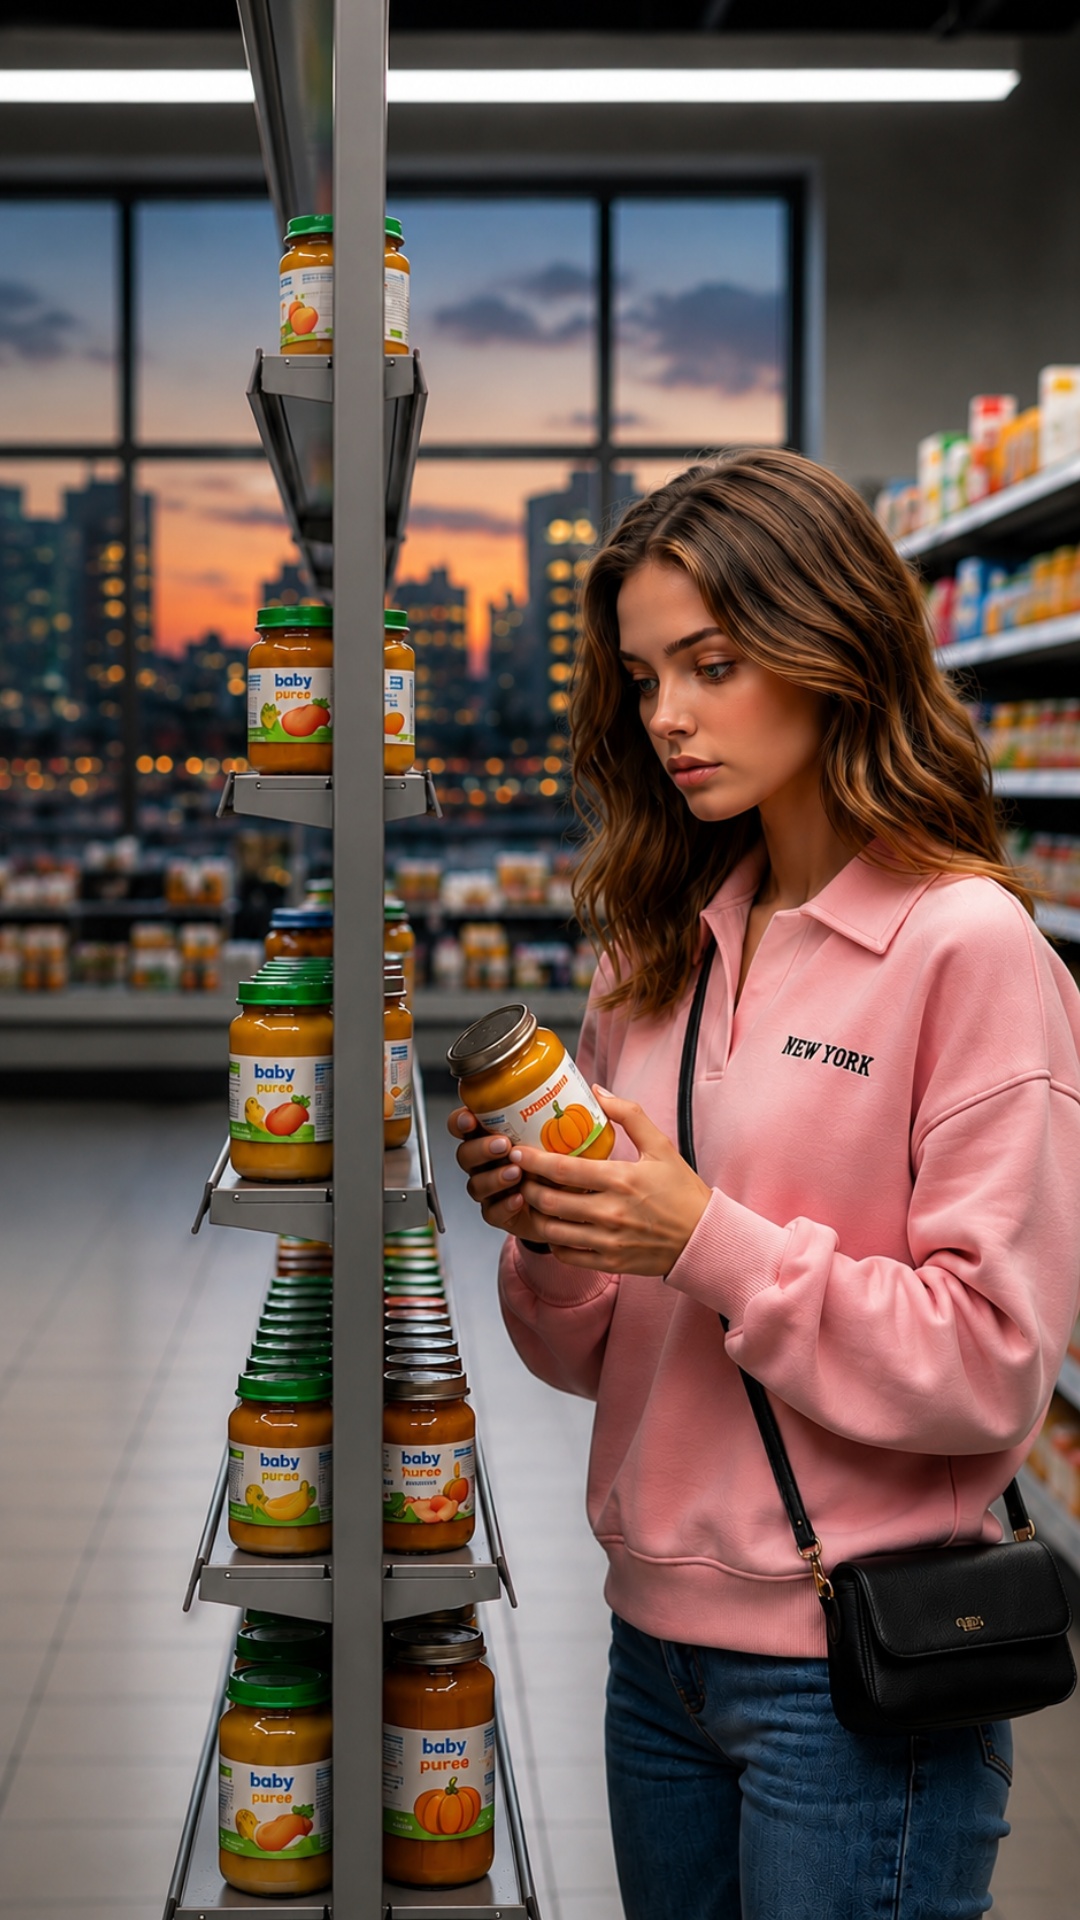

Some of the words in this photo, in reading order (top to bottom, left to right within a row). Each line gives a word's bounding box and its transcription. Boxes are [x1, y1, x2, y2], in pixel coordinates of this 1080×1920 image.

[275, 673, 312, 689] baby
[781, 1035, 822, 1060] NEW
[821, 1044, 874, 1077] YORK
[254, 1063, 295, 1082] baby
[260, 1453, 300, 1470] baby
[402, 1451, 441, 1467] baby
[422, 1738, 467, 1756] baby
[420, 1757, 469, 1774] puree
[250, 1772, 294, 1791] baby
[252, 1792, 292, 1805] puree
